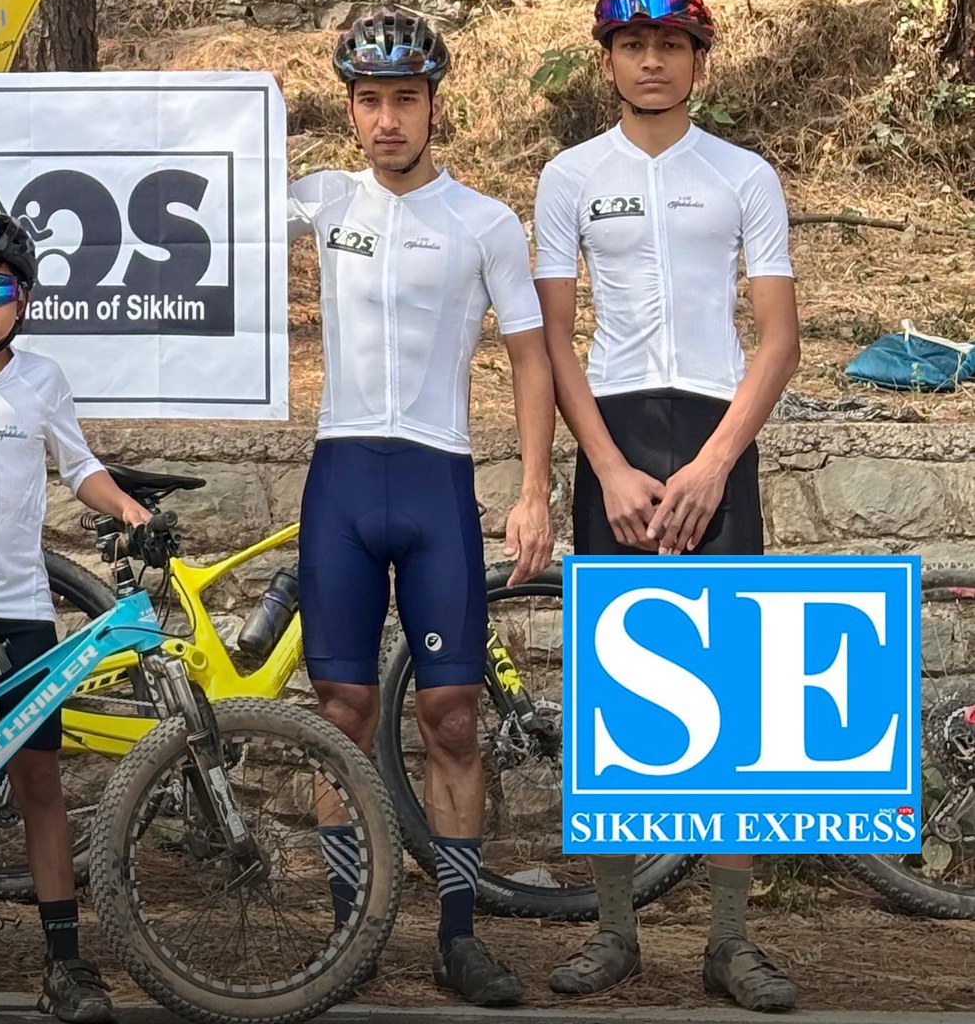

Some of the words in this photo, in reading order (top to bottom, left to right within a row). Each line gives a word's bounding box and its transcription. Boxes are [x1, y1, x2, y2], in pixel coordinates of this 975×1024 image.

[25, 294, 89, 320] iation
[96, 294, 120, 320] of
[126, 294, 205, 320] Sikkim
